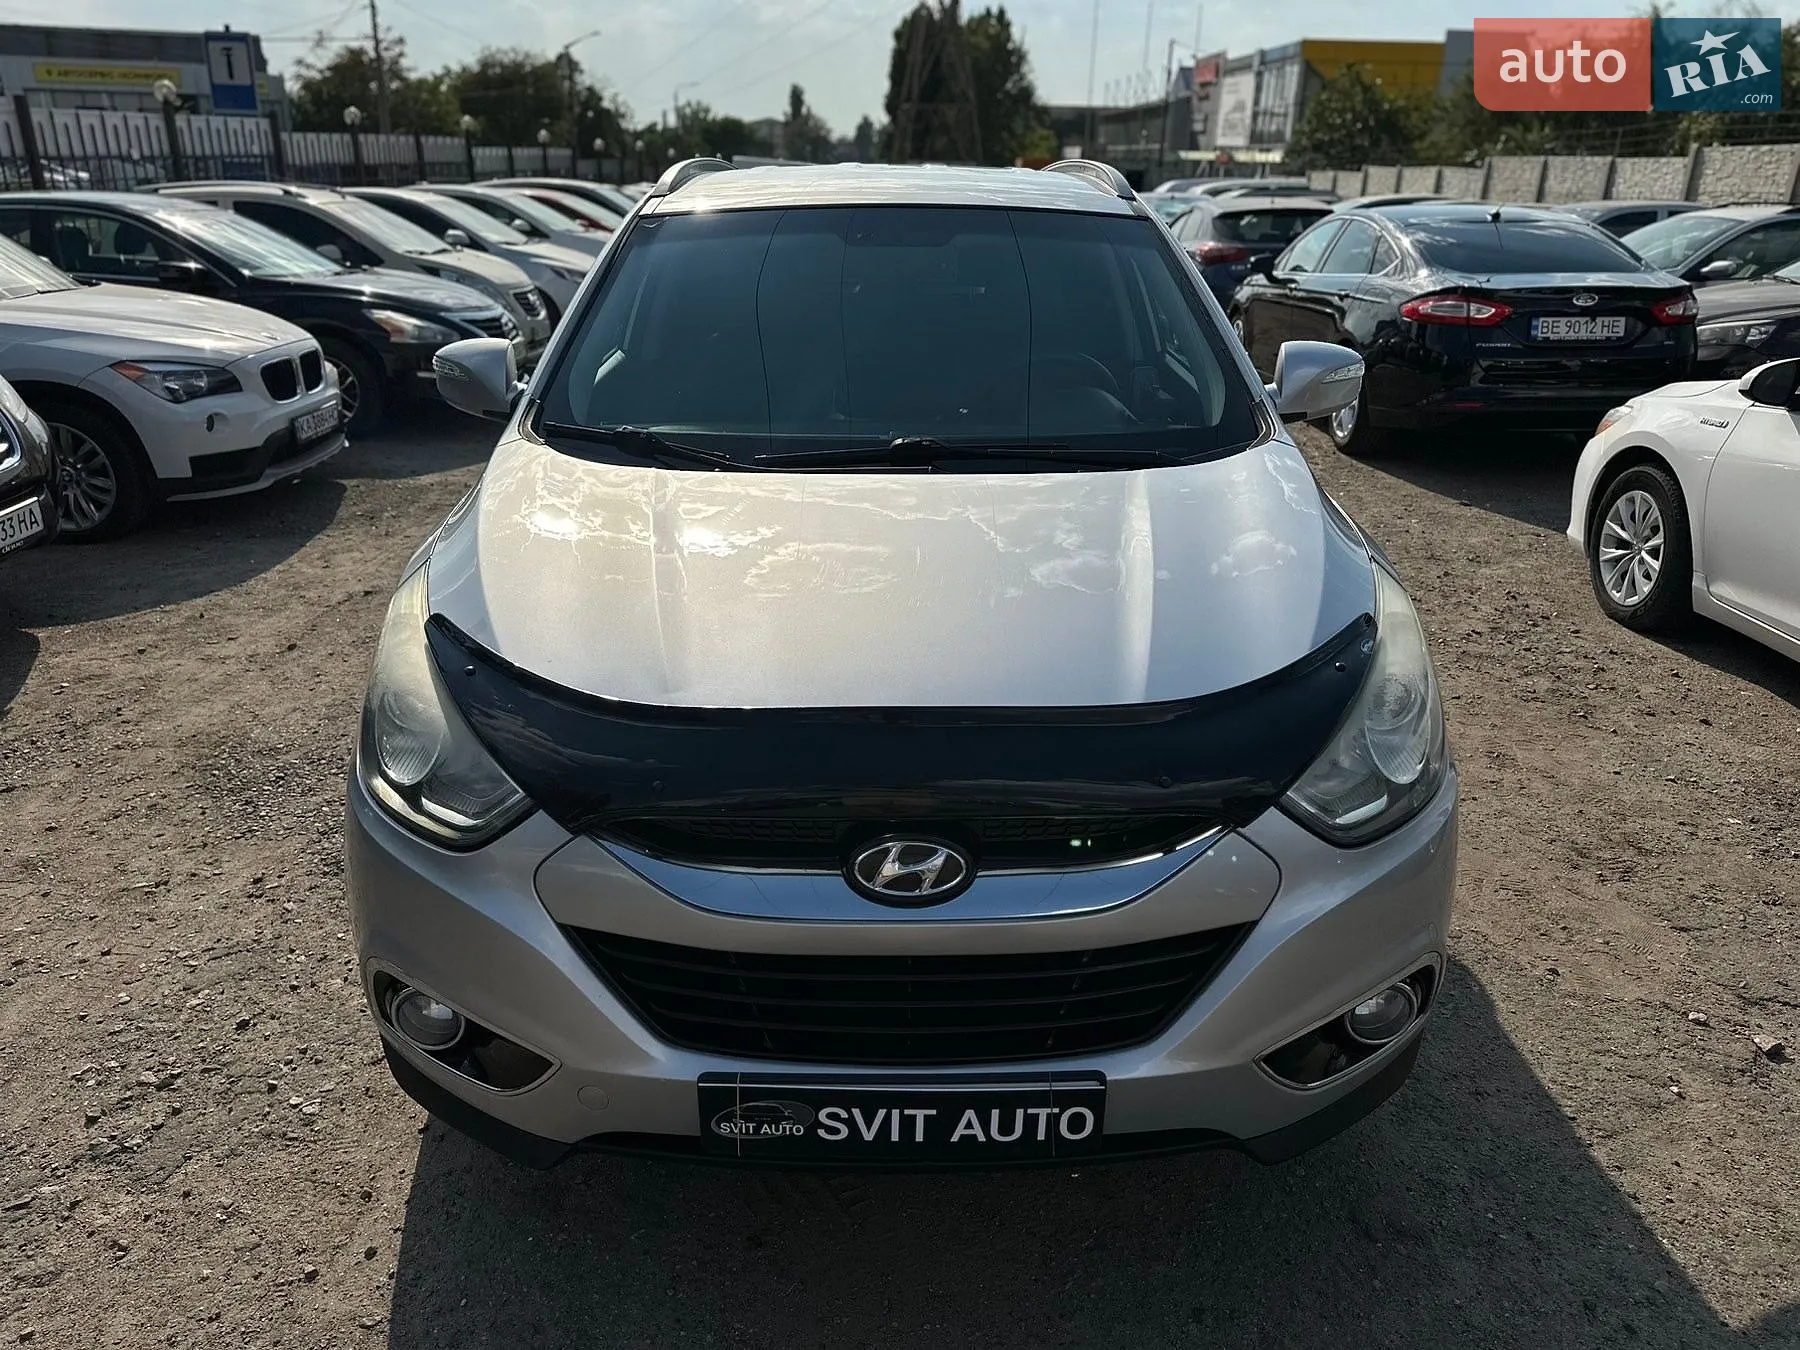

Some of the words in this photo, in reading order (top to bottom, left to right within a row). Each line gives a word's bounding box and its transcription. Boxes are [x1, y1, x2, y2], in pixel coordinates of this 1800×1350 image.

[1540, 319, 1561, 335] BE
[1564, 319, 1597, 335] 9012
[1600, 319, 1621, 335] HE
[17, 508, 40, 534] HA
[719, 1122, 757, 1135] SVIT
[760, 1123, 804, 1136] AUTO
[817, 1106, 937, 1143] SVIT
[950, 1105, 1095, 1143] AUTO
